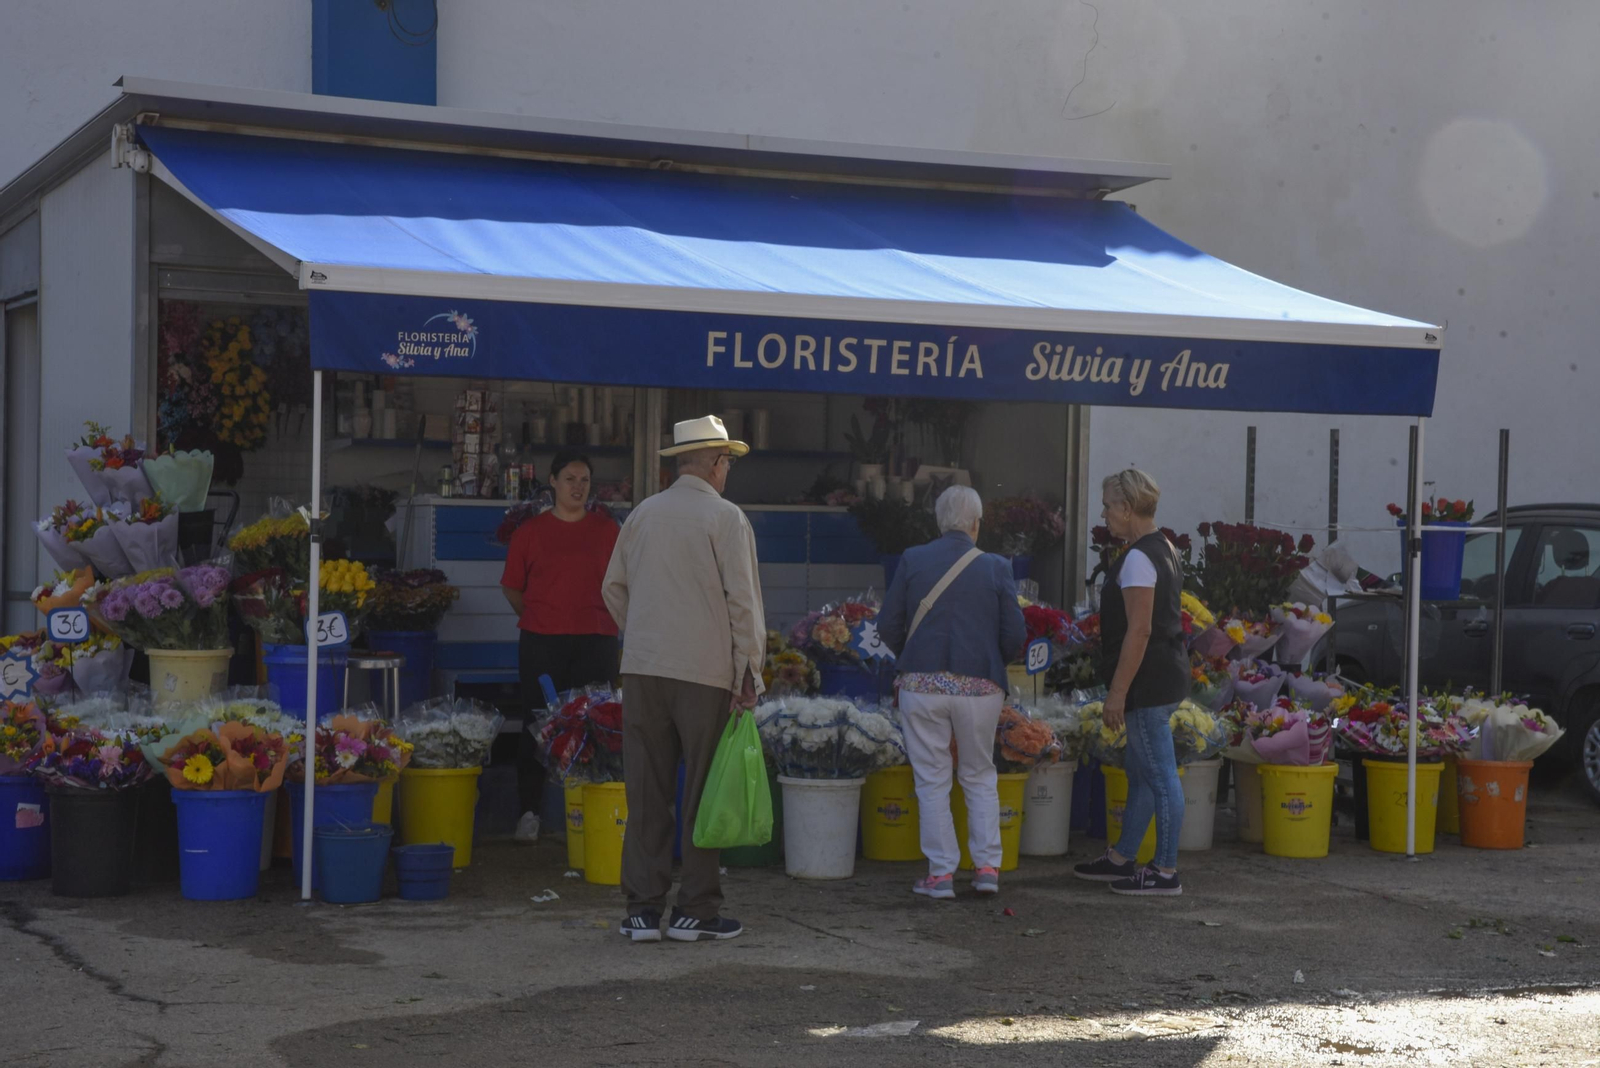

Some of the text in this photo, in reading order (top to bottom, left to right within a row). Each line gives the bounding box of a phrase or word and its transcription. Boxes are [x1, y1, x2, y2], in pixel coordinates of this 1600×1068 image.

[398, 331, 470, 344] FLORISTERÍA
[397, 341, 469, 360] Silvia y Ana
[706, 331, 1230, 397] FLORISTERÍA Silvia y Ana
[57, 613, 83, 635] 3€
[316, 616, 344, 643] 3€
